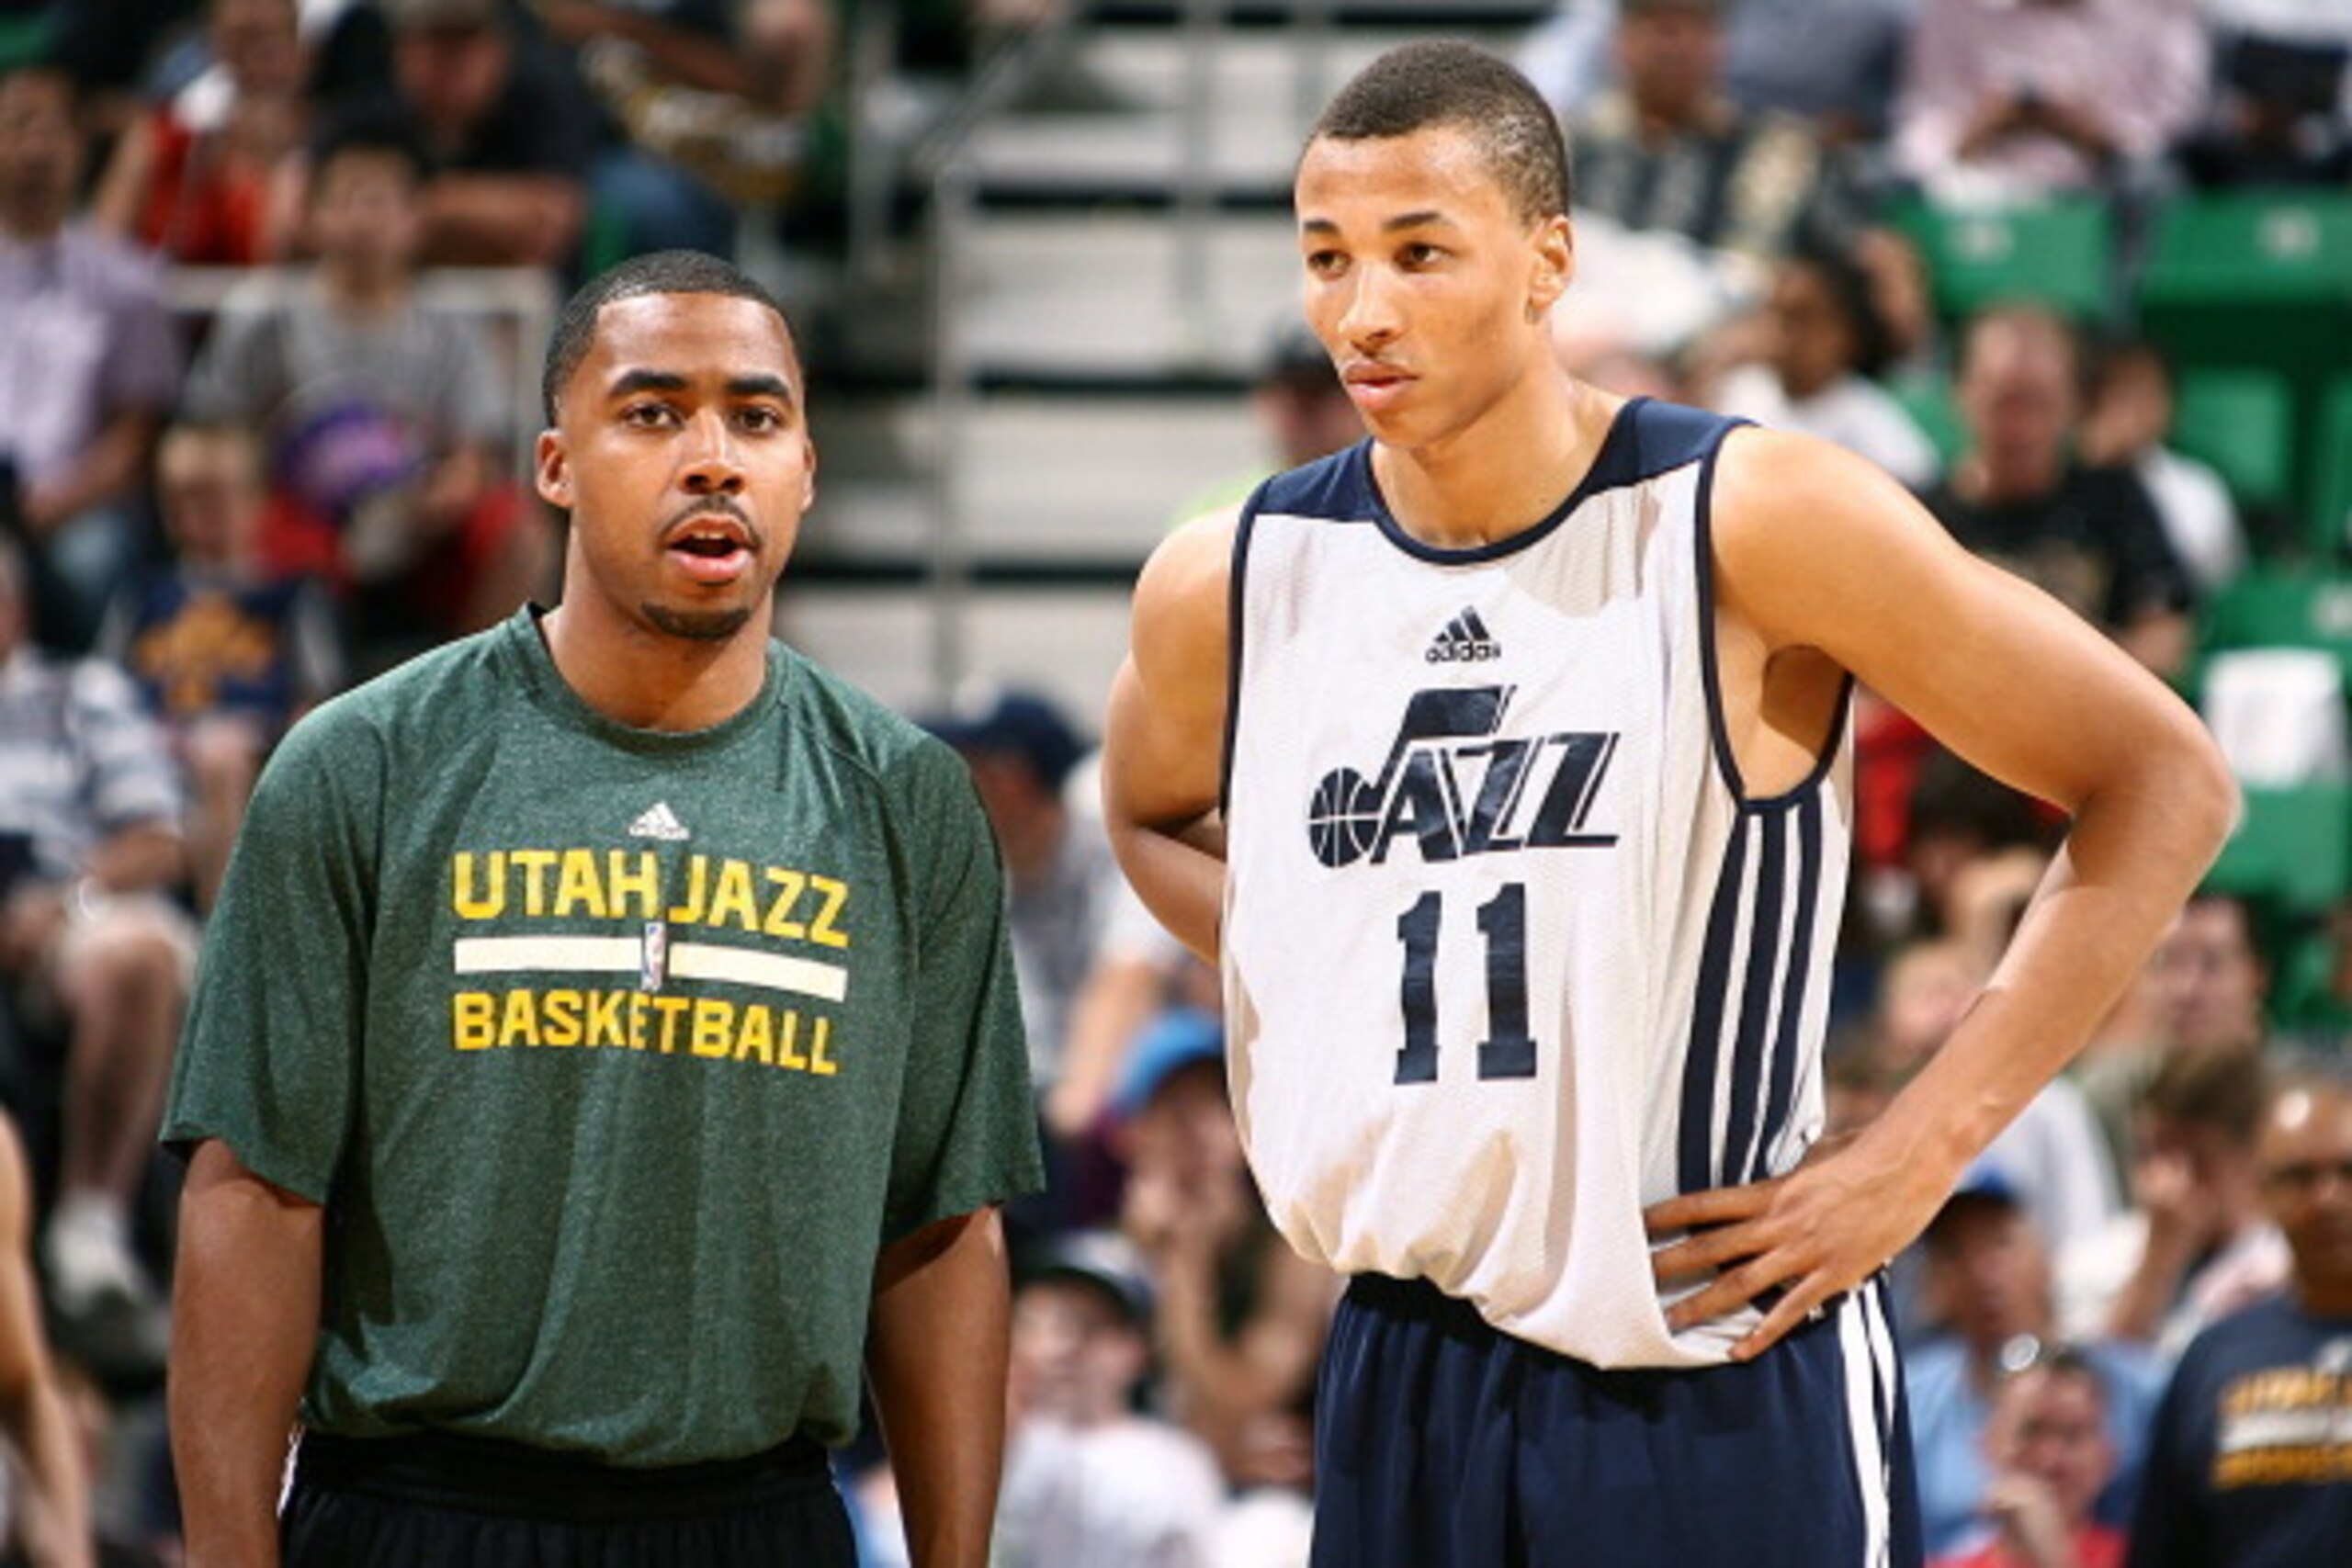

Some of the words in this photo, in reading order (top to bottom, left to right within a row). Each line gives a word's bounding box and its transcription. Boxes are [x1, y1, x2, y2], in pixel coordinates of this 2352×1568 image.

[1309, 684, 1620, 867] JAZZ
[453, 849, 660, 919] UTAH
[668, 854, 850, 947] JAZZ
[453, 988, 837, 1076] BASKETBALL
[1393, 883, 1537, 1085] 11
